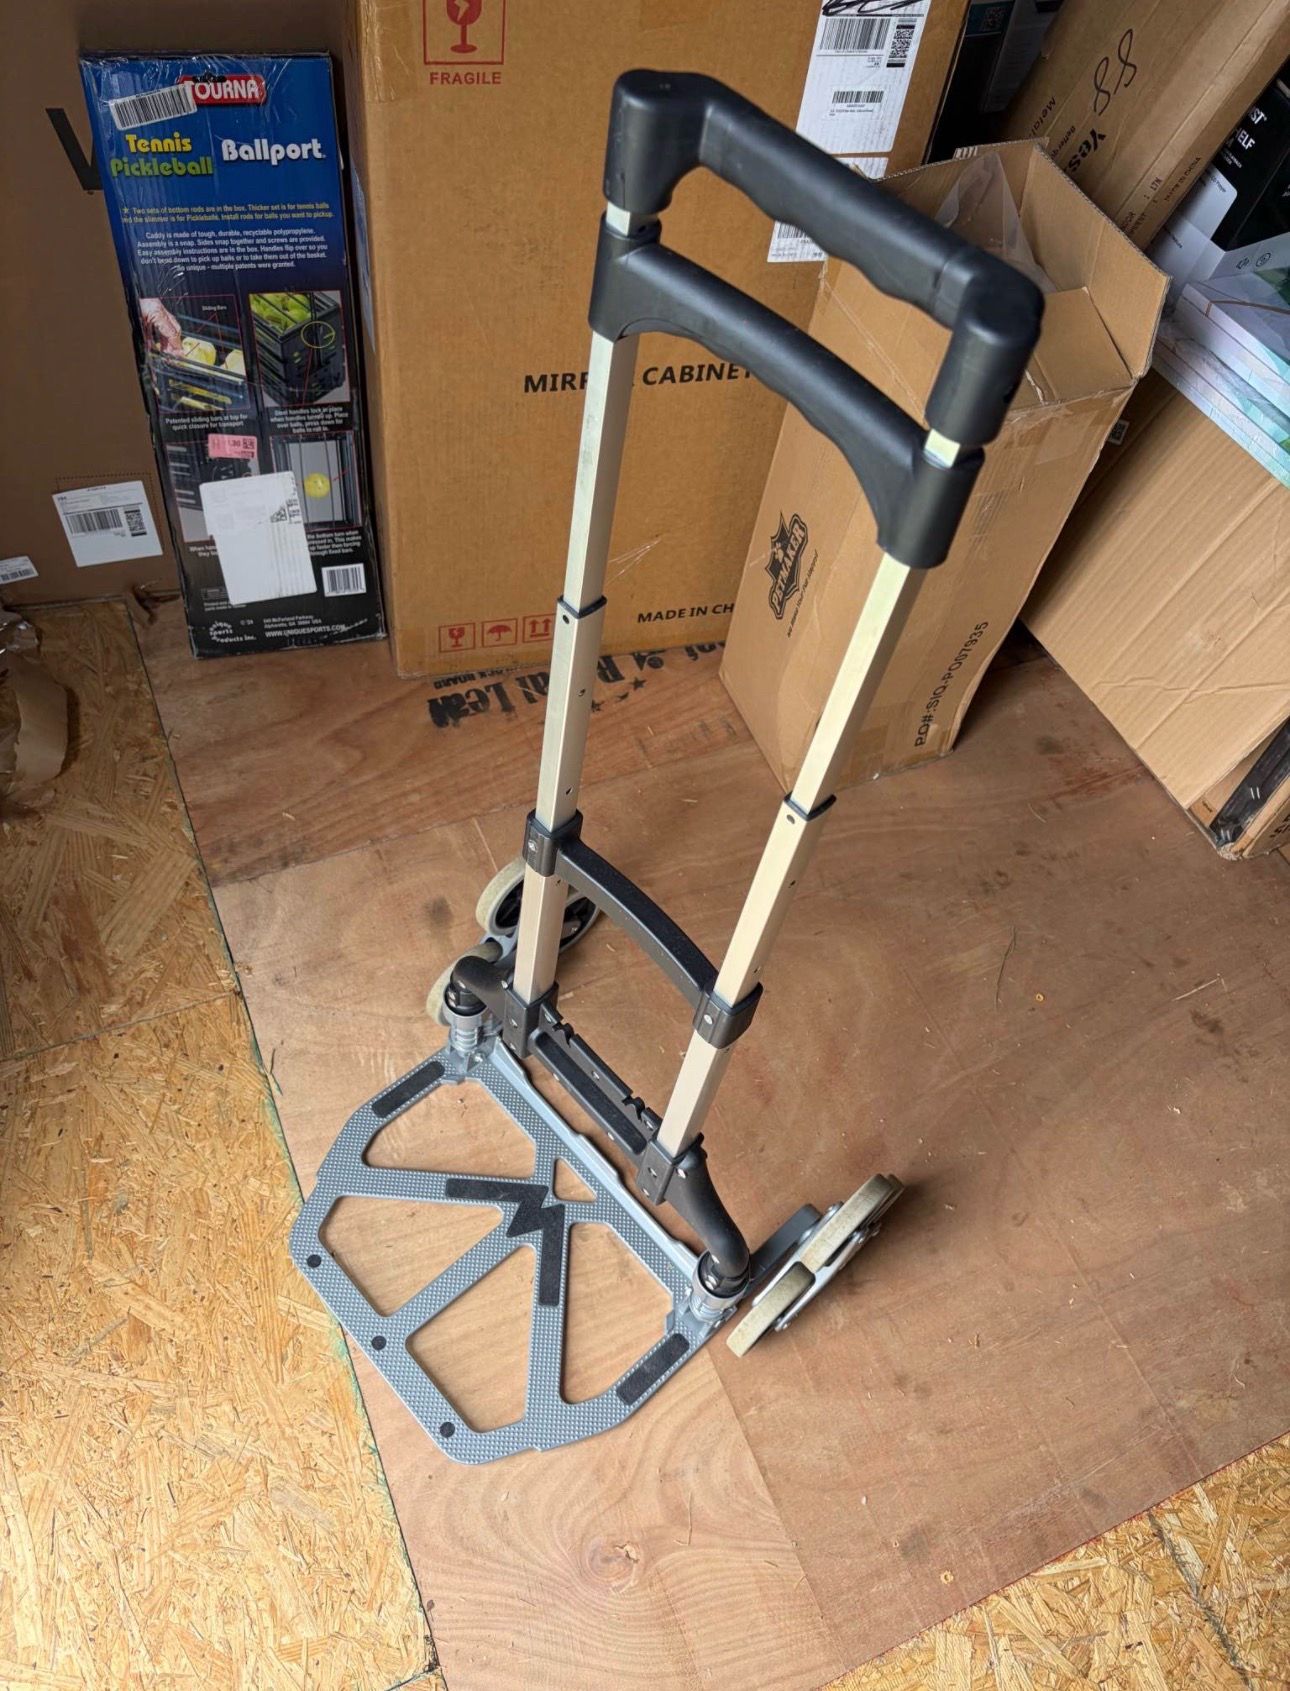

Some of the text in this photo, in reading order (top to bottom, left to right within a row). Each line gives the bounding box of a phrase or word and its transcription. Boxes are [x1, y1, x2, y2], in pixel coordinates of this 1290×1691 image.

[429, 71, 502, 86] FRAGILE
[125, 131, 193, 153] Tennis
[221, 138, 323, 166] Ballport
[1064, 128, 1106, 173] Yes
[110, 155, 214, 178] Pickleball
[771, 521, 806, 615] PETMAKER
[637, 608, 687, 623] MADE
[689, 605, 708, 617] IN
